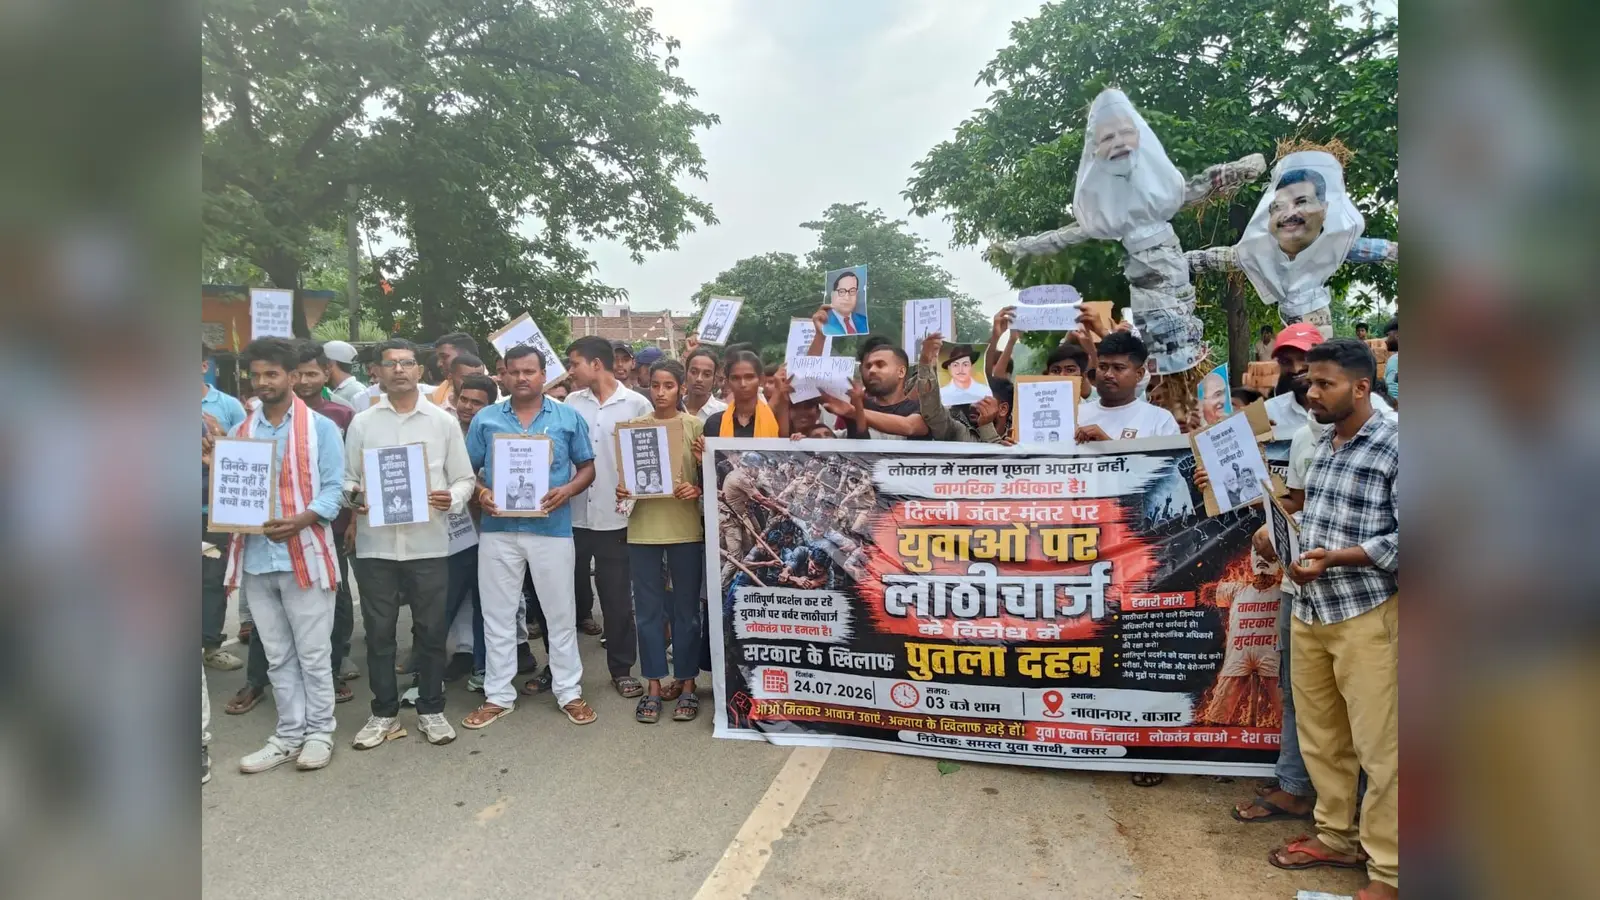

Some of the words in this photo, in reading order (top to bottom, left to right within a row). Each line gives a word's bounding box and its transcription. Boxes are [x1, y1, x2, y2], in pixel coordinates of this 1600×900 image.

[220, 456, 248, 472] जिनके
[250, 463, 269, 474] बाल
[888, 462, 937, 477] लोकतंत्र
[941, 461, 954, 476] में
[958, 463, 998, 477] सवाल
[1002, 463, 1040, 479] पूछना
[1096, 457, 1130, 473] नहीं,
[221, 472, 240, 484] बच्चे
[242, 474, 257, 486] नहीं
[933, 478, 995, 496] नागरिक
[1000, 478, 1064, 496] अधिकार
[1067, 477, 1087, 494] है!
[228, 486, 240, 496] क्या
[242, 486, 248, 496] ही
[240, 498, 250, 508] का
[252, 498, 264, 511] दर्द
[904, 500, 960, 522] दिल्ली
[965, 502, 1064, 522] जंतर-मंतर
[1071, 503, 1100, 521] पर
[897, 522, 1038, 572] युवाओं
[1039, 526, 1100, 563] पर
[881, 561, 1113, 620] लाठीचार्ज
[743, 592, 774, 606] शांतिपूर्ण
[804, 597, 819, 606] कर
[821, 595, 833, 607] रहे
[1130, 594, 1160, 608] हमारी
[1237, 601, 1280, 613] तानाशाह
[740, 607, 766, 621] युवाओं
[768, 609, 780, 619] पर
[781, 608, 799, 620] बर्बर
[800, 609, 838, 622] लाठीचार्ज
[1121, 611, 1149, 621] लाठीचार्ज
[1150, 611, 1164, 619] करने
[1165, 610, 1178, 619] वाले
[1179, 609, 1205, 618] जिम्मेदार
[745, 621, 778, 633] लोकतंत्र
[780, 624, 792, 634] पर
[794, 625, 820, 636] हमला
[821, 625, 833, 637] है!
[918, 619, 944, 636] के
[952, 621, 1029, 640] विरोध
[1035, 623, 1065, 640] में
[1189, 619, 1199, 629] हो!
[1238, 617, 1277, 629] सरकार
[1121, 641, 1131, 649] की
[1233, 632, 1277, 650] मुर्दाबाद!
[742, 643, 802, 663] सरकार
[806, 643, 823, 666] के
[828, 646, 895, 672] खिलाफ
[904, 642, 1008, 681] पुतला
[1014, 647, 1104, 679] दहन
[1147, 650, 1167, 659] प्रदर्शन
[1167, 650, 1178, 659] को
[1143, 660, 1157, 669] पेपर
[1157, 660, 1173, 670] लीक
[1174, 661, 1187, 670] और
[1157, 672, 1176, 680] जवाब
[794, 679, 873, 700] 24.07.2026
[925, 686, 950, 696] समय:
[1070, 692, 1096, 701] स्थान:
[925, 696, 945, 710] 03
[949, 699, 970, 713] बजे
[974, 701, 1001, 713] शाम
[783, 702, 821, 717] मिलकर
[824, 707, 855, 721] आवाज
[888, 715, 923, 729] अन्याय
[926, 717, 936, 730] के
[940, 718, 981, 733] खिलाफ
[984, 722, 1005, 737] खड़े
[1008, 722, 1026, 736] हों!
[1142, 710, 1182, 723] बाजार
[1036, 726, 1056, 741] युवा
[1058, 728, 1088, 741] एकता
[1090, 727, 1140, 742] जिंदाबाद!
[1148, 729, 1190, 742] लोकतंत्र
[1192, 729, 1228, 743] बचाओ
[1240, 729, 1261, 744] देश
[917, 733, 962, 746] निवेदक:
[966, 739, 1002, 750] समस्त
[1006, 742, 1029, 753] युवा
[1033, 744, 1067, 755] साथी,
[1071, 746, 1108, 755] बक्सर
